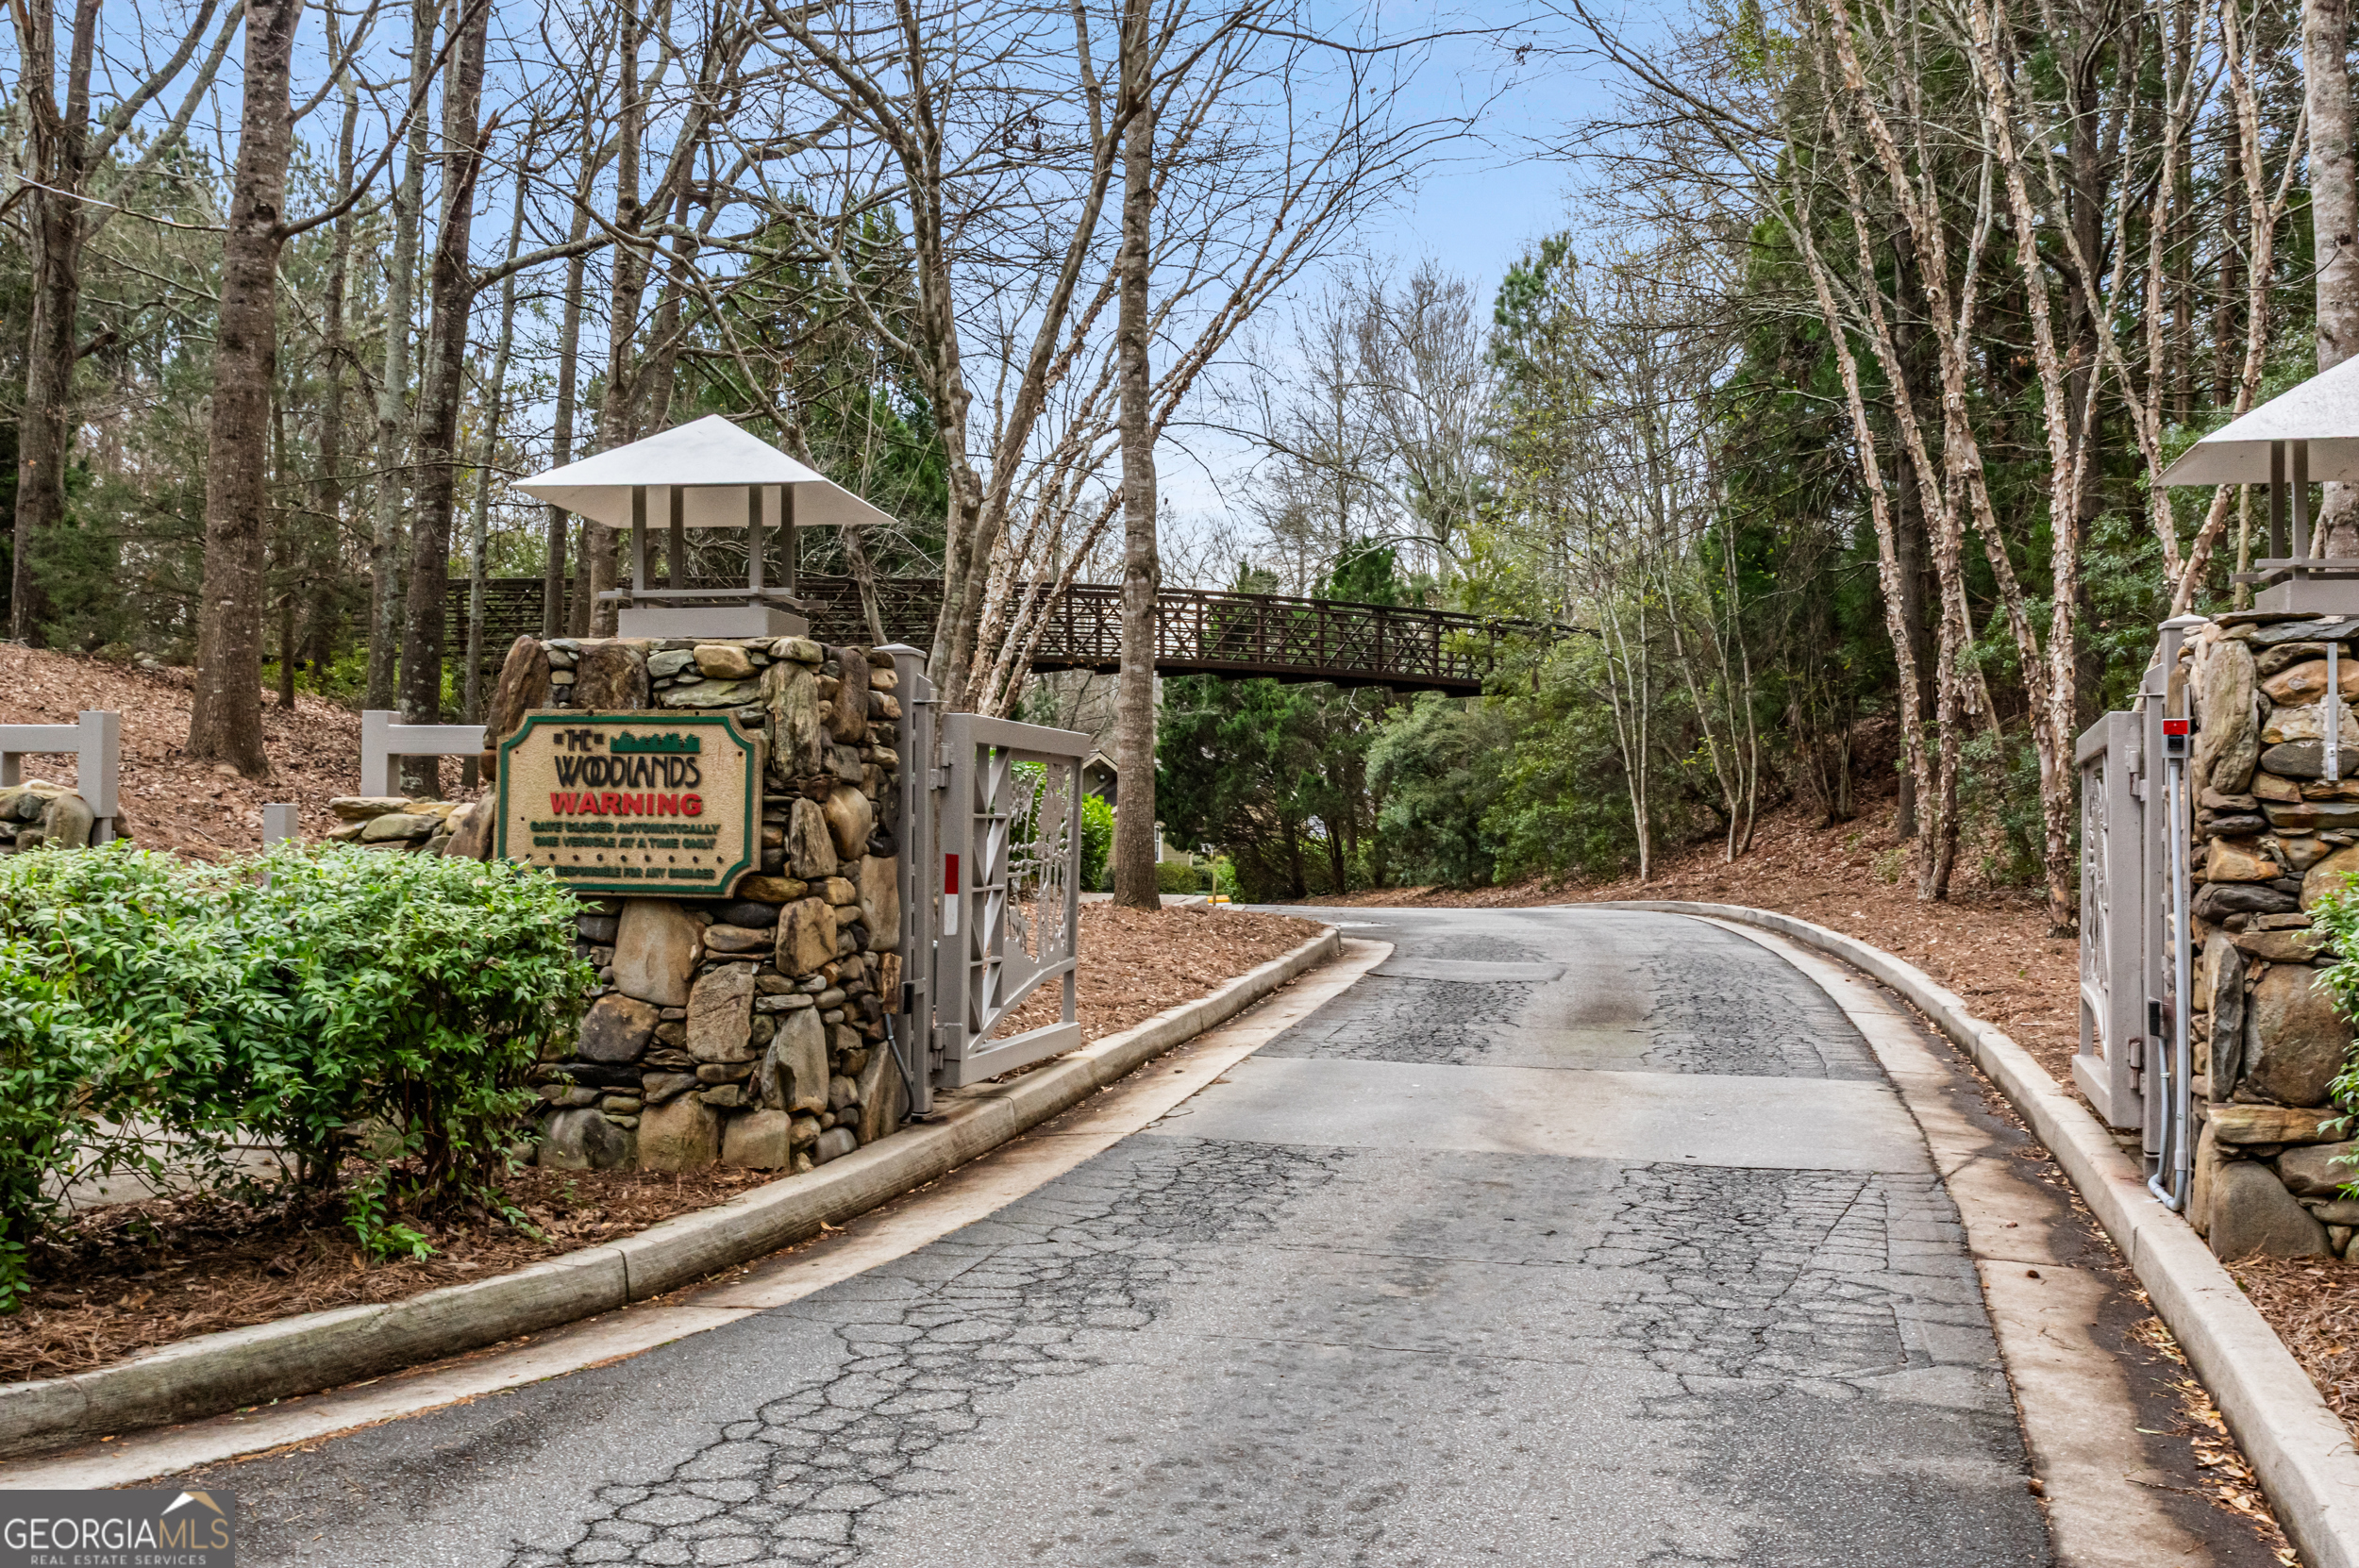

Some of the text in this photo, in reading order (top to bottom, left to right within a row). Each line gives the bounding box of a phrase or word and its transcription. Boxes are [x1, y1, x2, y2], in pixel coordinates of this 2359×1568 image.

[564, 729, 593, 752] THE
[554, 756, 702, 788] WOODLANDS
[550, 792, 703, 816] WARNING
[530, 821, 721, 835] GATE CLOSES AUTOMATICALLY
[533, 836, 717, 850] ONE VEHICLE AT A TIME ONLY
[554, 865, 622, 878] RESPONSIBLE
[623, 866, 643, 878] FOR
[645, 867, 667, 879] ANY
[668, 868, 717, 880] DAMAGES
